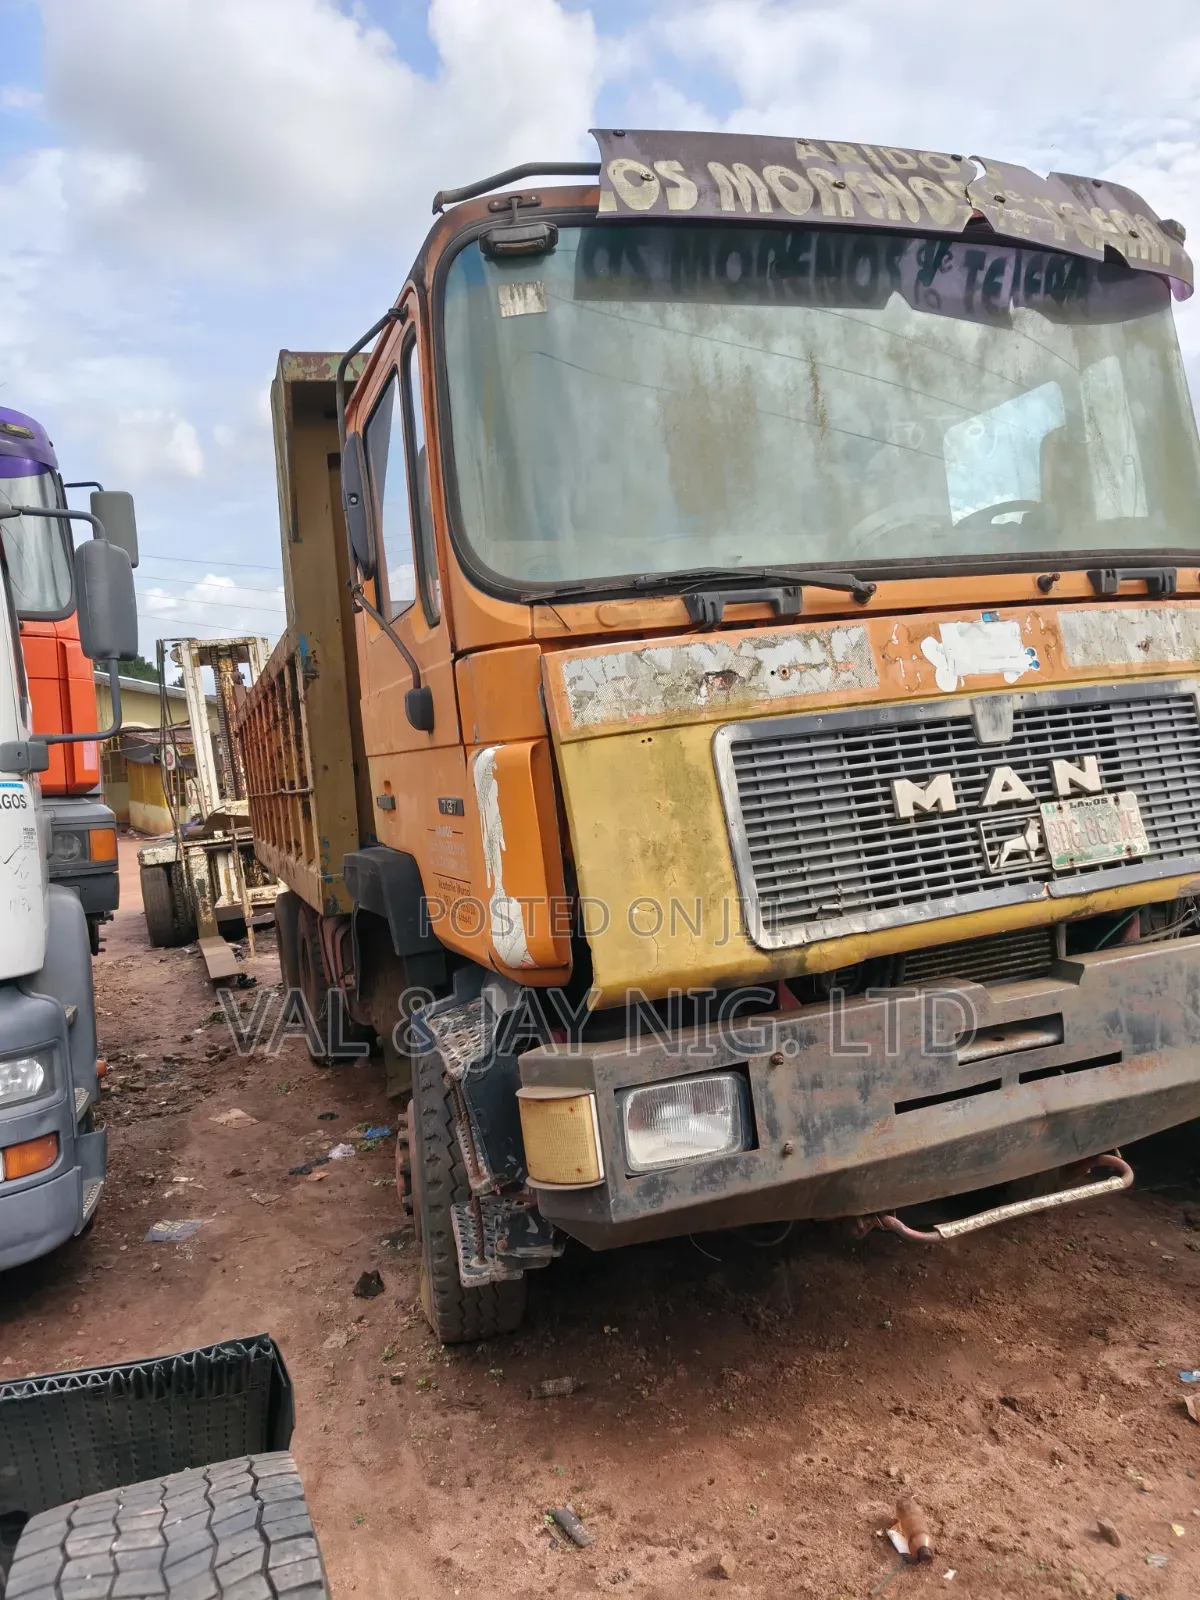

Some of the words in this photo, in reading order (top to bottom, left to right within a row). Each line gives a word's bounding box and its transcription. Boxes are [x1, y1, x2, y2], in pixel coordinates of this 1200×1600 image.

[890, 755, 1102, 819] MAN
[0, 793, 28, 809] GOS
[1069, 797, 1109, 809] LAGOS
